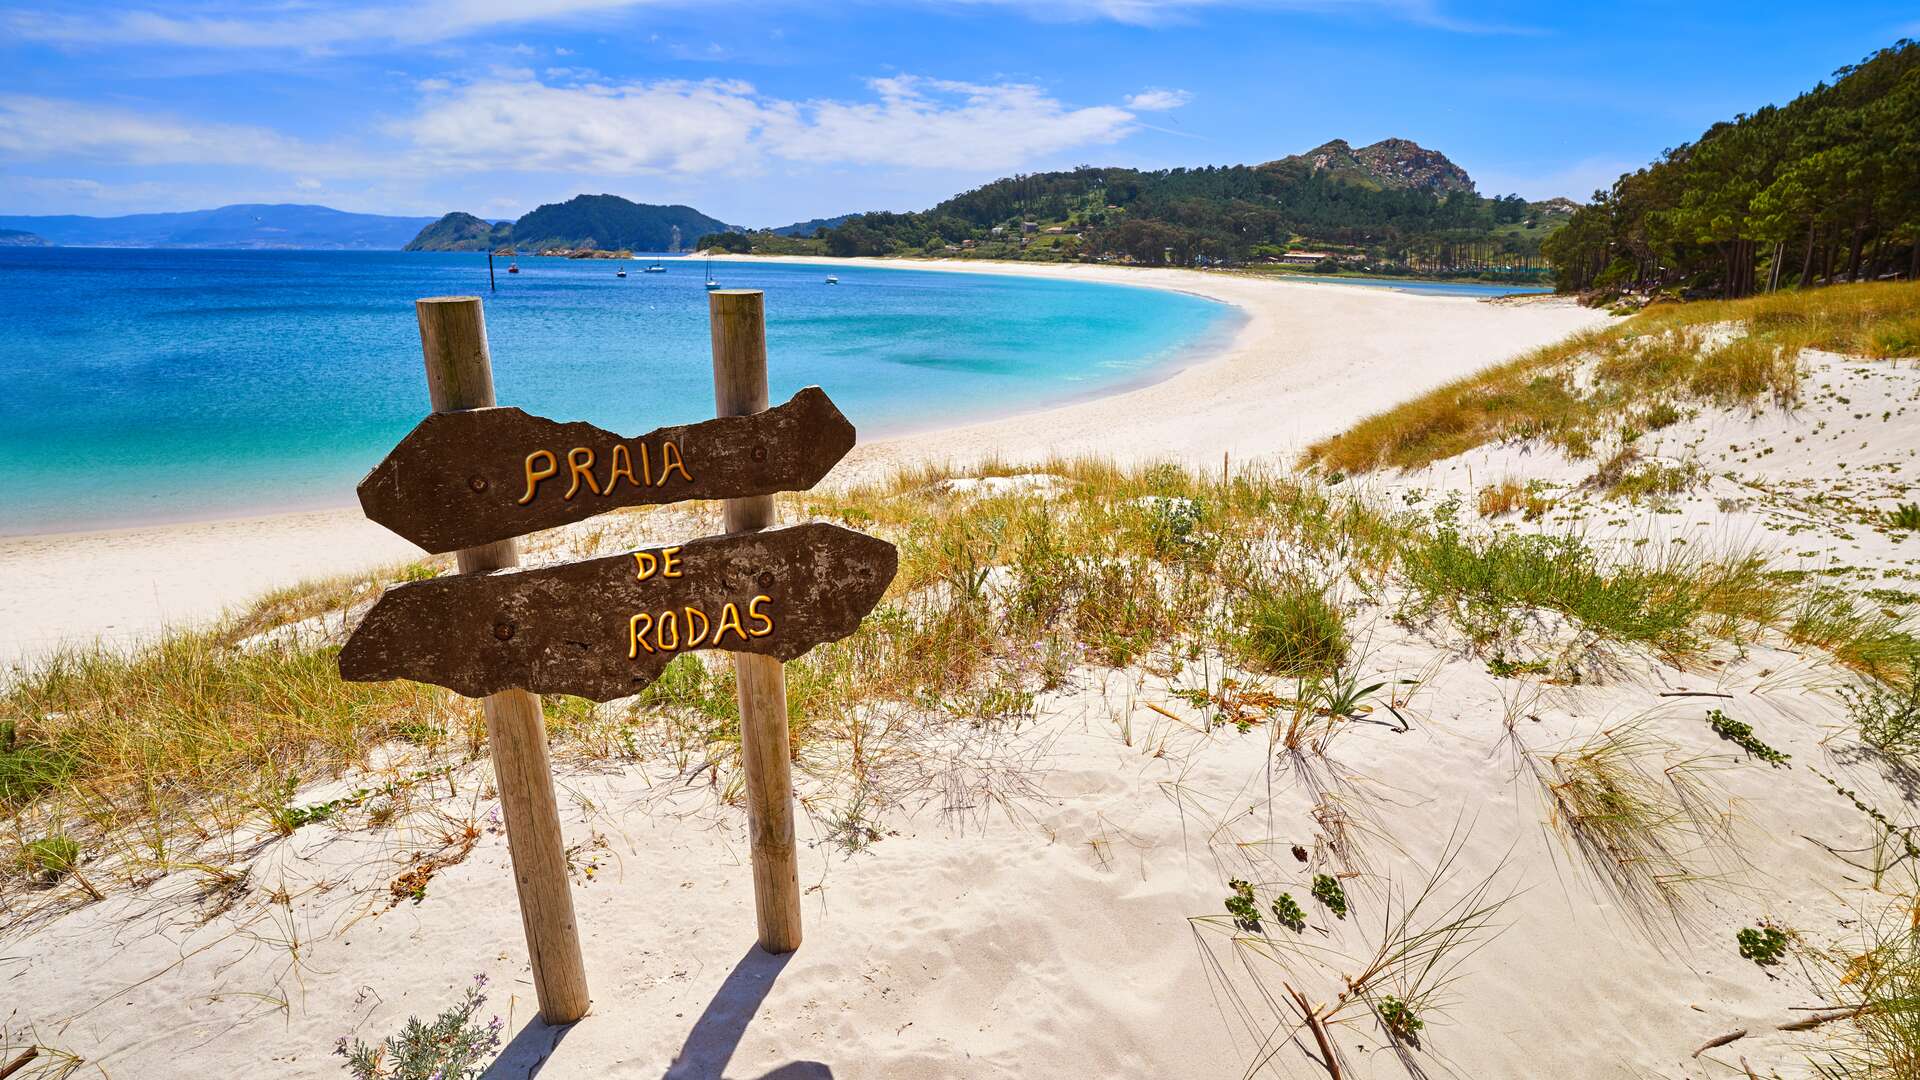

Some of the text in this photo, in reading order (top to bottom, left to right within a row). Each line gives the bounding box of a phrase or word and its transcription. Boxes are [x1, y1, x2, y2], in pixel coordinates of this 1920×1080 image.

[519, 442, 693, 504] PRAIA
[634, 547, 683, 580] DE
[629, 596, 773, 658] RODAS
